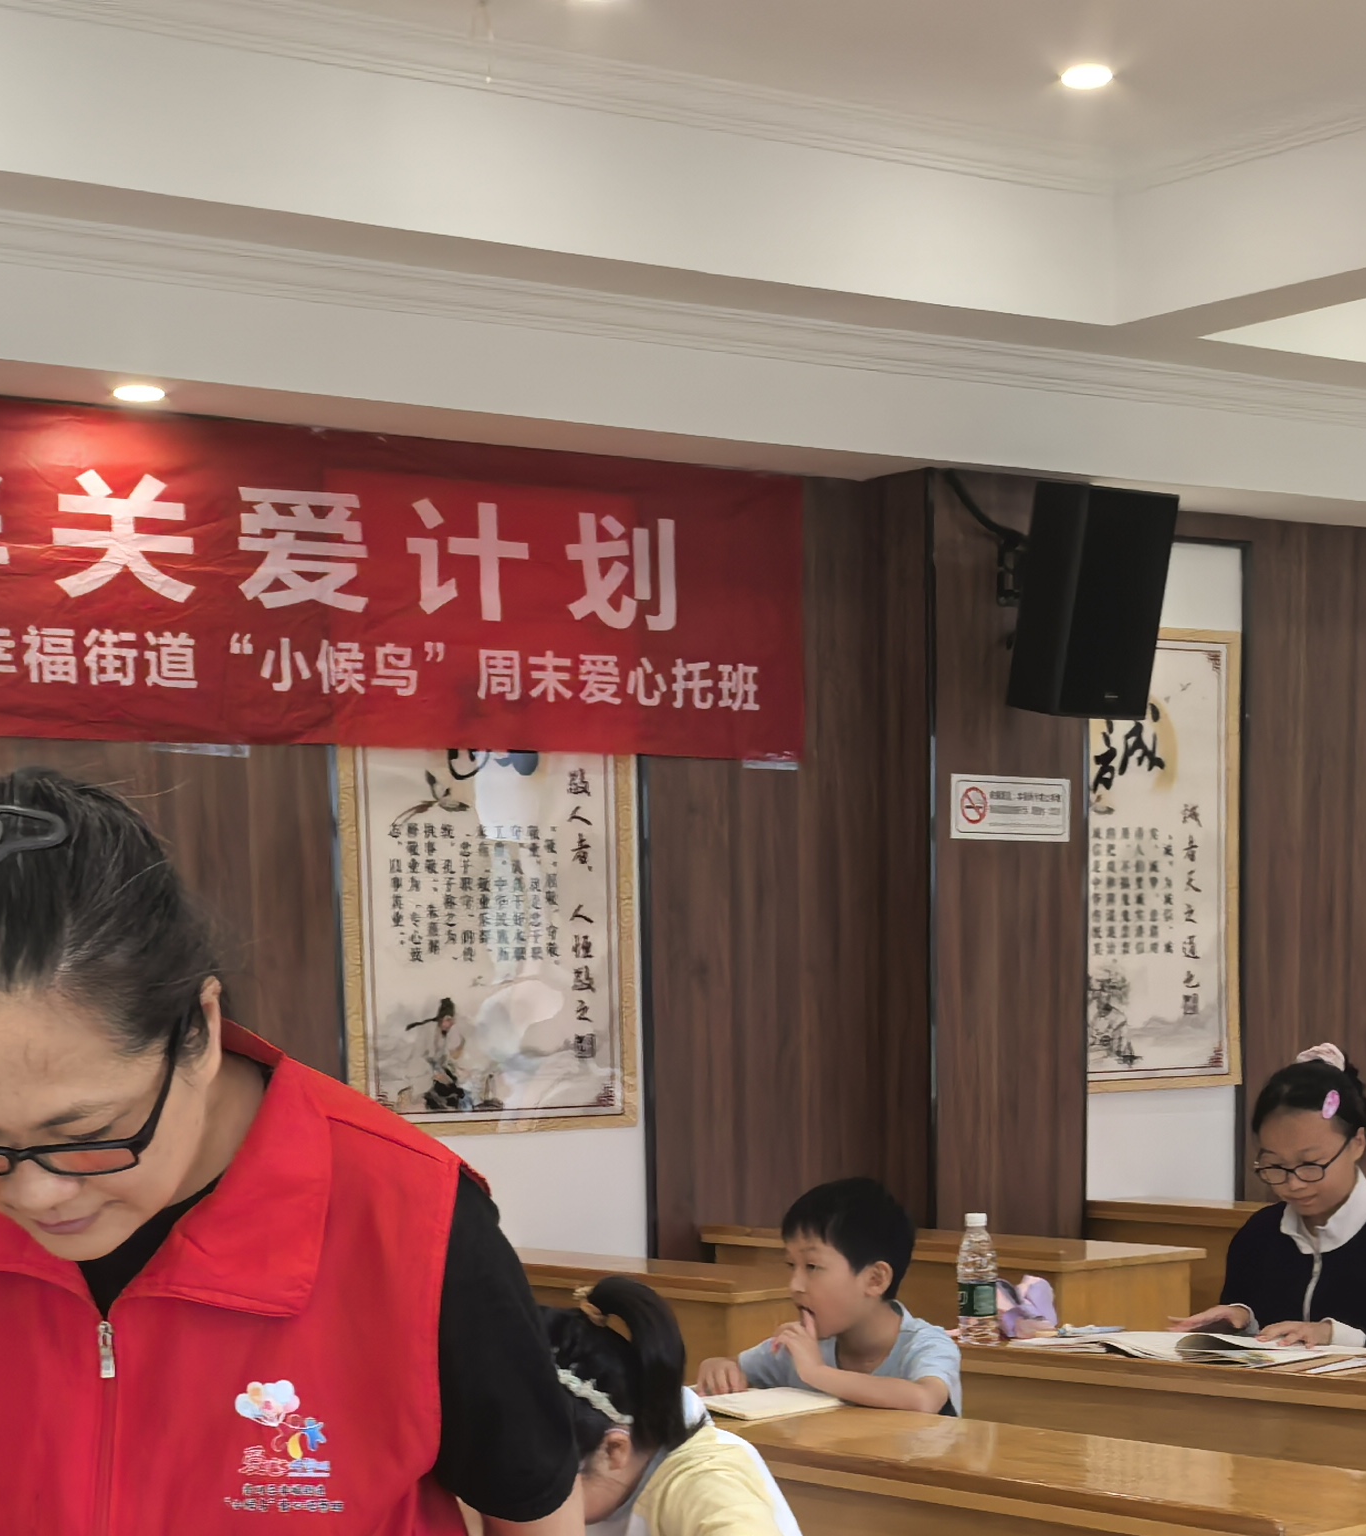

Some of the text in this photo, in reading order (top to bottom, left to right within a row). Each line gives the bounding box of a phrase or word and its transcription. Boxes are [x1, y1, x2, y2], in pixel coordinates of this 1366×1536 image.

[477, 650, 763, 716] 周末爱心托班
